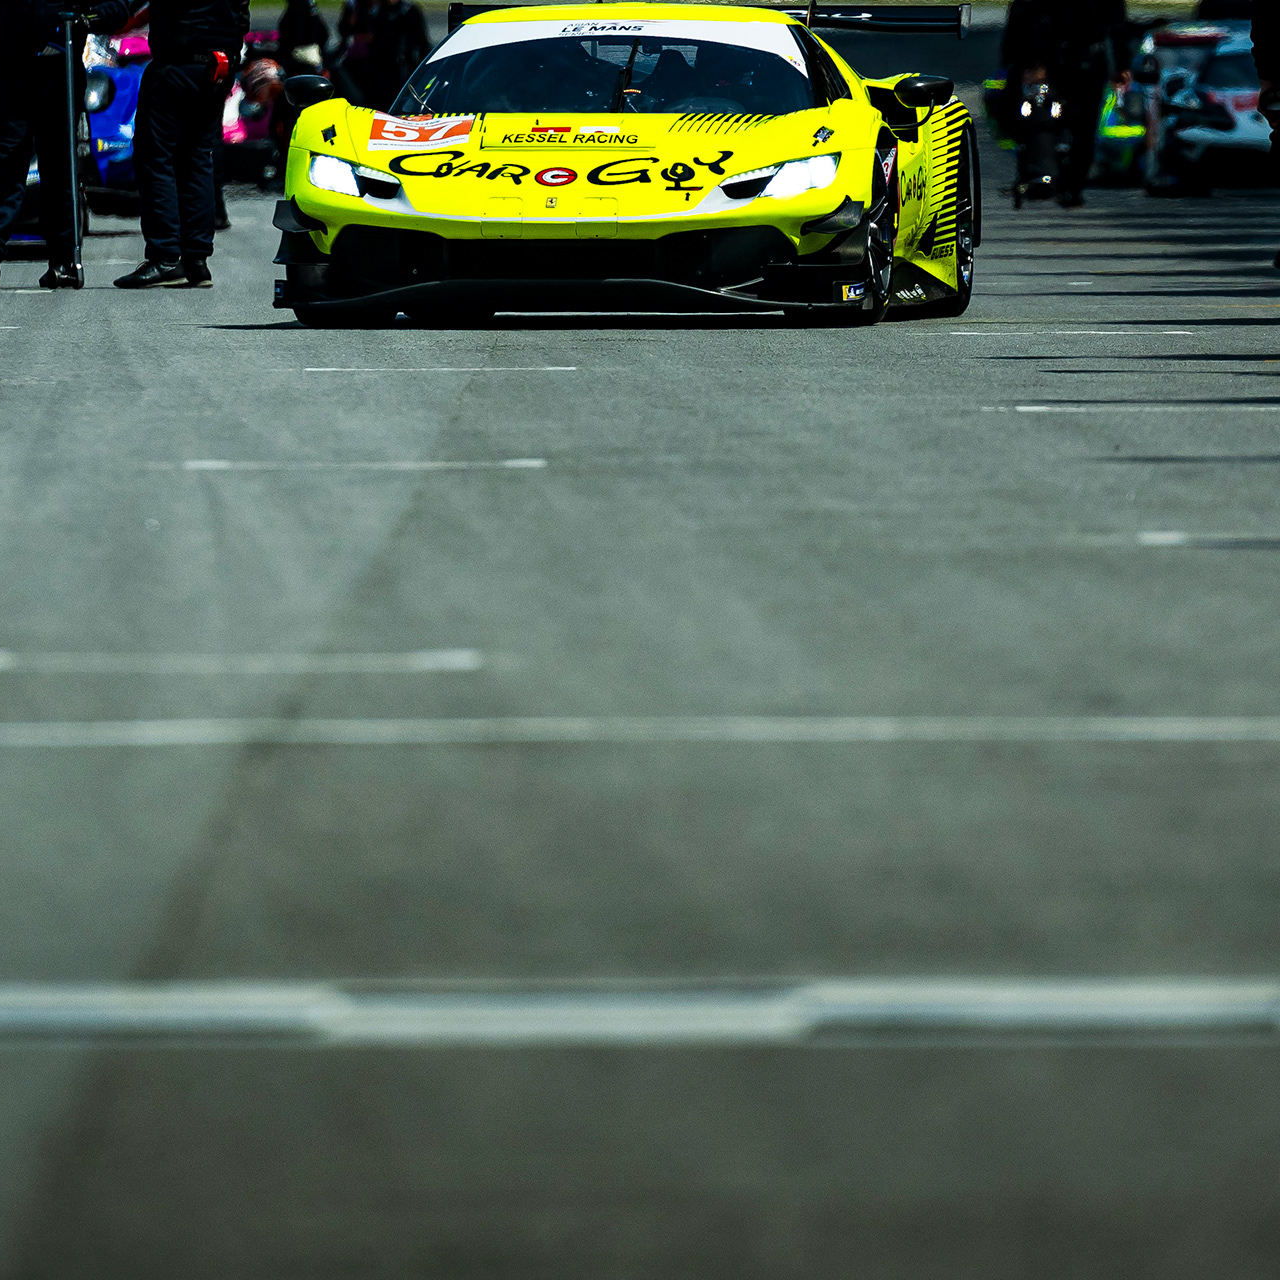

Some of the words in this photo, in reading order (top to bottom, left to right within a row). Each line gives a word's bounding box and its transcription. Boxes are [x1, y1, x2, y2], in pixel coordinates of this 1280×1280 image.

[380, 120, 463, 141] 57
[501, 133, 568, 144] KESSEL
[573, 133, 639, 144] RACING
[931, 243, 955, 260] GUESS
